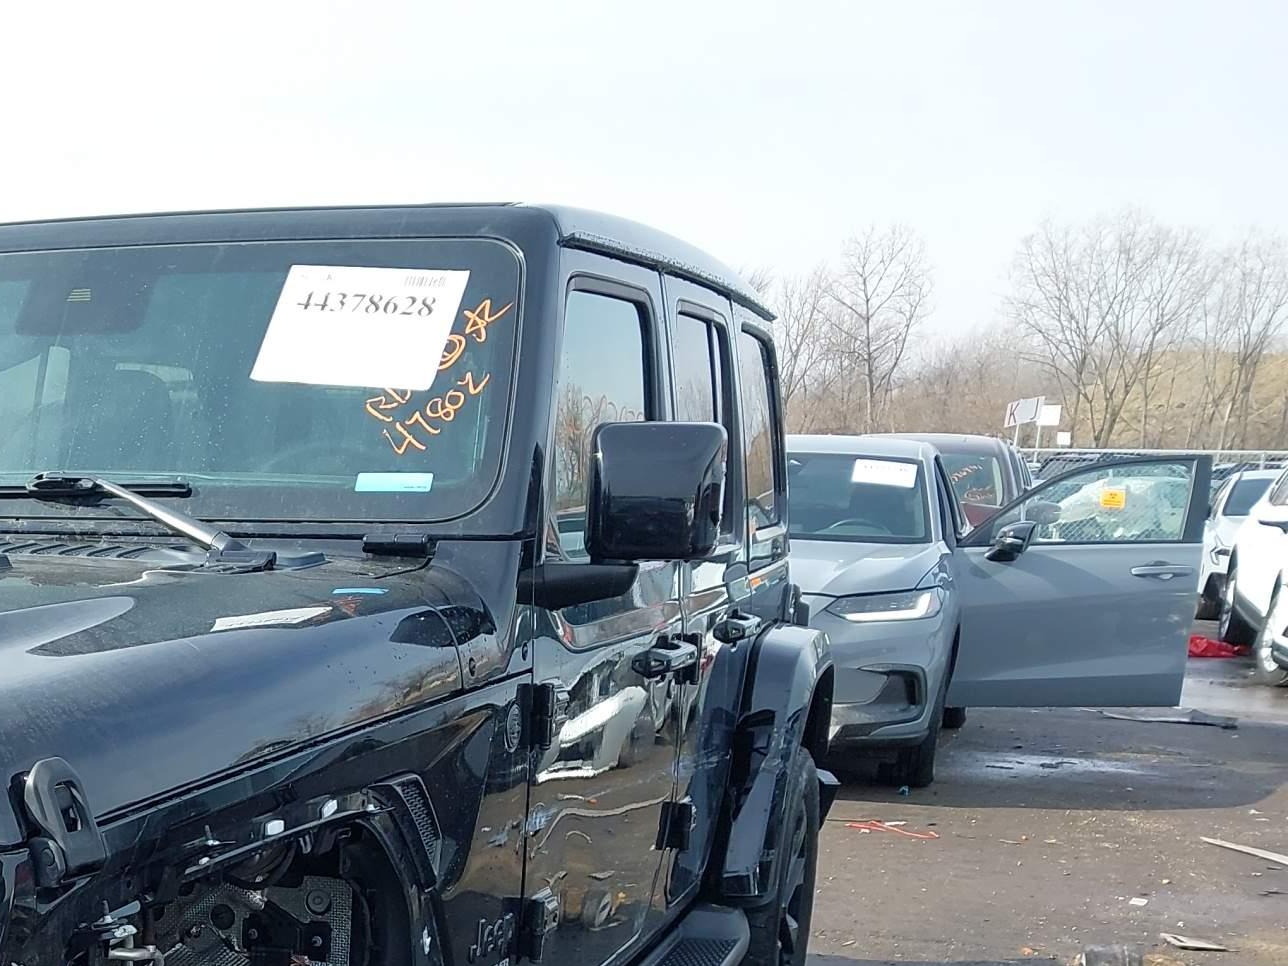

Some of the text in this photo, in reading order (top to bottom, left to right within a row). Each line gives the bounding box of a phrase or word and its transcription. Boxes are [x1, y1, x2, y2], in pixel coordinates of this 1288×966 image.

[297, 290, 437, 317] 44378628
[1007, 397, 1040, 426] K J
